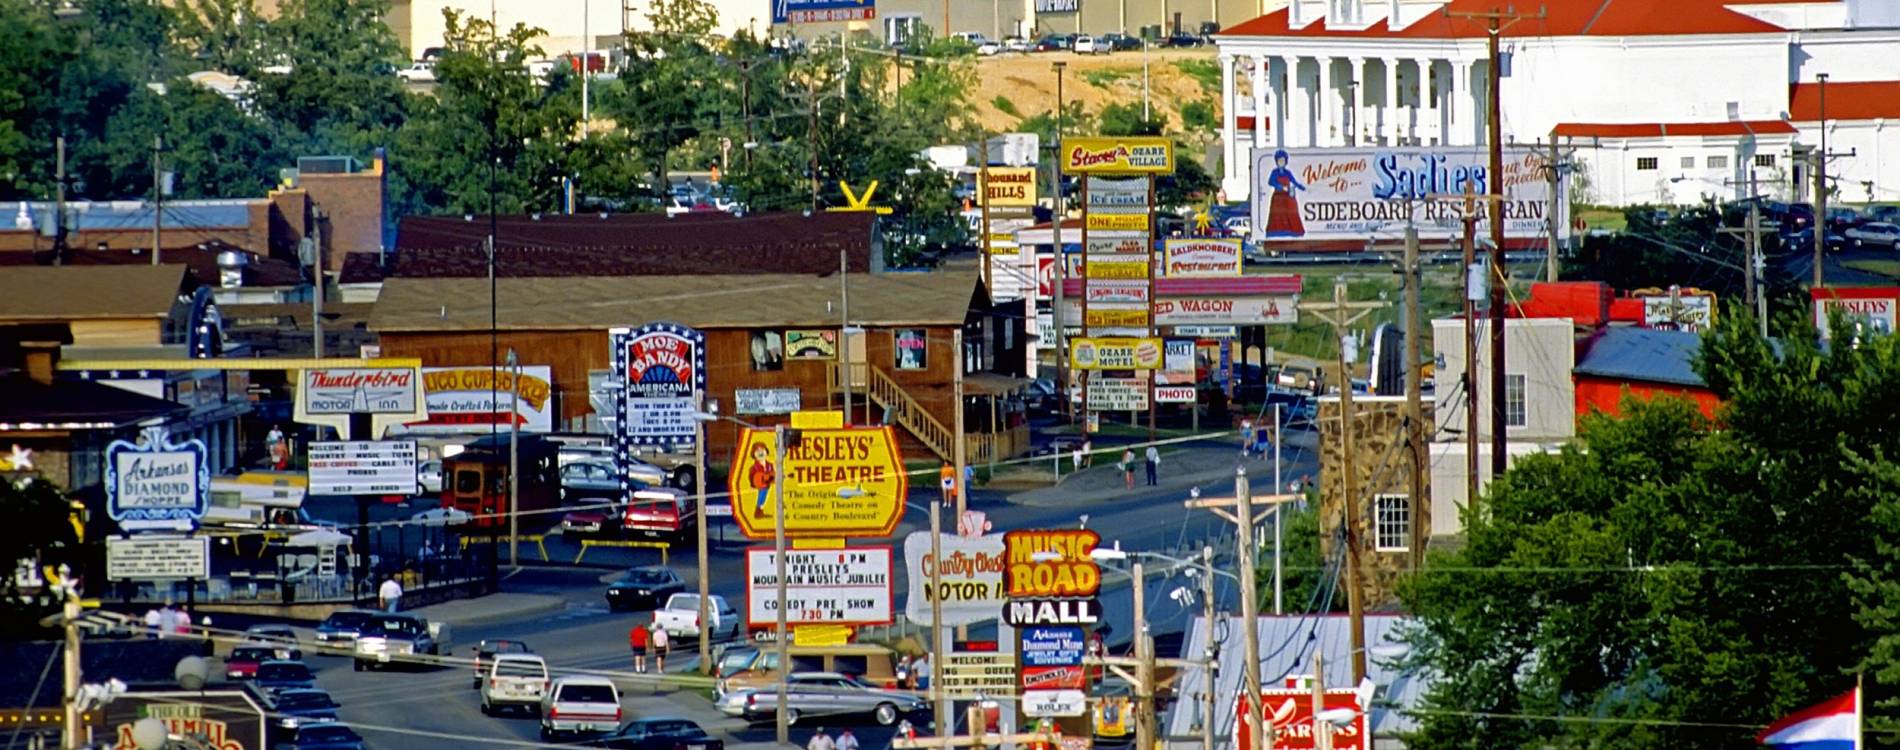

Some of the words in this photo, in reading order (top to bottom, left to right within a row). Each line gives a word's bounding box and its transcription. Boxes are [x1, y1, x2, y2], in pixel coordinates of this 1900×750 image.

[1071, 146, 1129, 167] Stacey's
[1132, 147, 1164, 156] OZARK
[1129, 157, 1167, 166] VILLAGE
[979, 171, 1031, 183] housand
[1303, 158, 1367, 185] Welcome
[987, 187, 1025, 199] HILLS
[1091, 196, 1106, 204] ICE
[1110, 195, 1144, 204] CREAM
[1090, 217, 1110, 226] ONE
[1512, 221, 1544, 229] DINNER
[1171, 261, 1237, 273] Restaurant
[1155, 302, 1174, 314] ED
[1180, 300, 1234, 313] WAGON
[640, 337, 680, 352] MOE
[900, 338, 924, 348] OPEN
[1100, 347, 1133, 357] OZARK
[1166, 342, 1192, 356] ARKET
[631, 352, 692, 374] BANDY
[1099, 357, 1134, 367] MOTEL
[310, 371, 410, 388] Thunderbird
[425, 374, 459, 392] LICO
[630, 383, 691, 393] AMERICANA
[1158, 390, 1193, 399] PHOTO
[311, 401, 351, 410] MOTOR
[784, 436, 874, 461] RESLEYS'
[125, 457, 189, 481] Arkansas
[125, 483, 190, 496] DIAMOND
[134, 496, 182, 504] SHOPPE
[792, 502, 824, 510] Comedy
[793, 511, 828, 521] Country
[1010, 534, 1095, 563] MUSIC
[769, 554, 815, 564] TNIGHT
[839, 554, 844, 563] 8
[850, 554, 866, 563] PM
[922, 551, 974, 578] Cuntry
[793, 564, 849, 574] PRESLEYS
[753, 575, 803, 585] MOUNAIN
[808, 575, 841, 584] MUSIC
[847, 573, 886, 584] JUBILEE
[1011, 563, 1097, 593] ROAD
[764, 599, 806, 610] COEDY
[816, 599, 836, 609] PRE
[847, 598, 875, 609] SHOW
[830, 609, 844, 619] PM
[1010, 601, 1098, 624] MALL
[1033, 629, 1073, 640] Arkansas
[1023, 639, 1061, 651] Diamond
[1063, 639, 1084, 651] Mine
[951, 656, 998, 665] WELCOME
[941, 667, 958, 675] ING
[149, 706, 174, 717] THE
[1037, 703, 1071, 711] ROLEX
